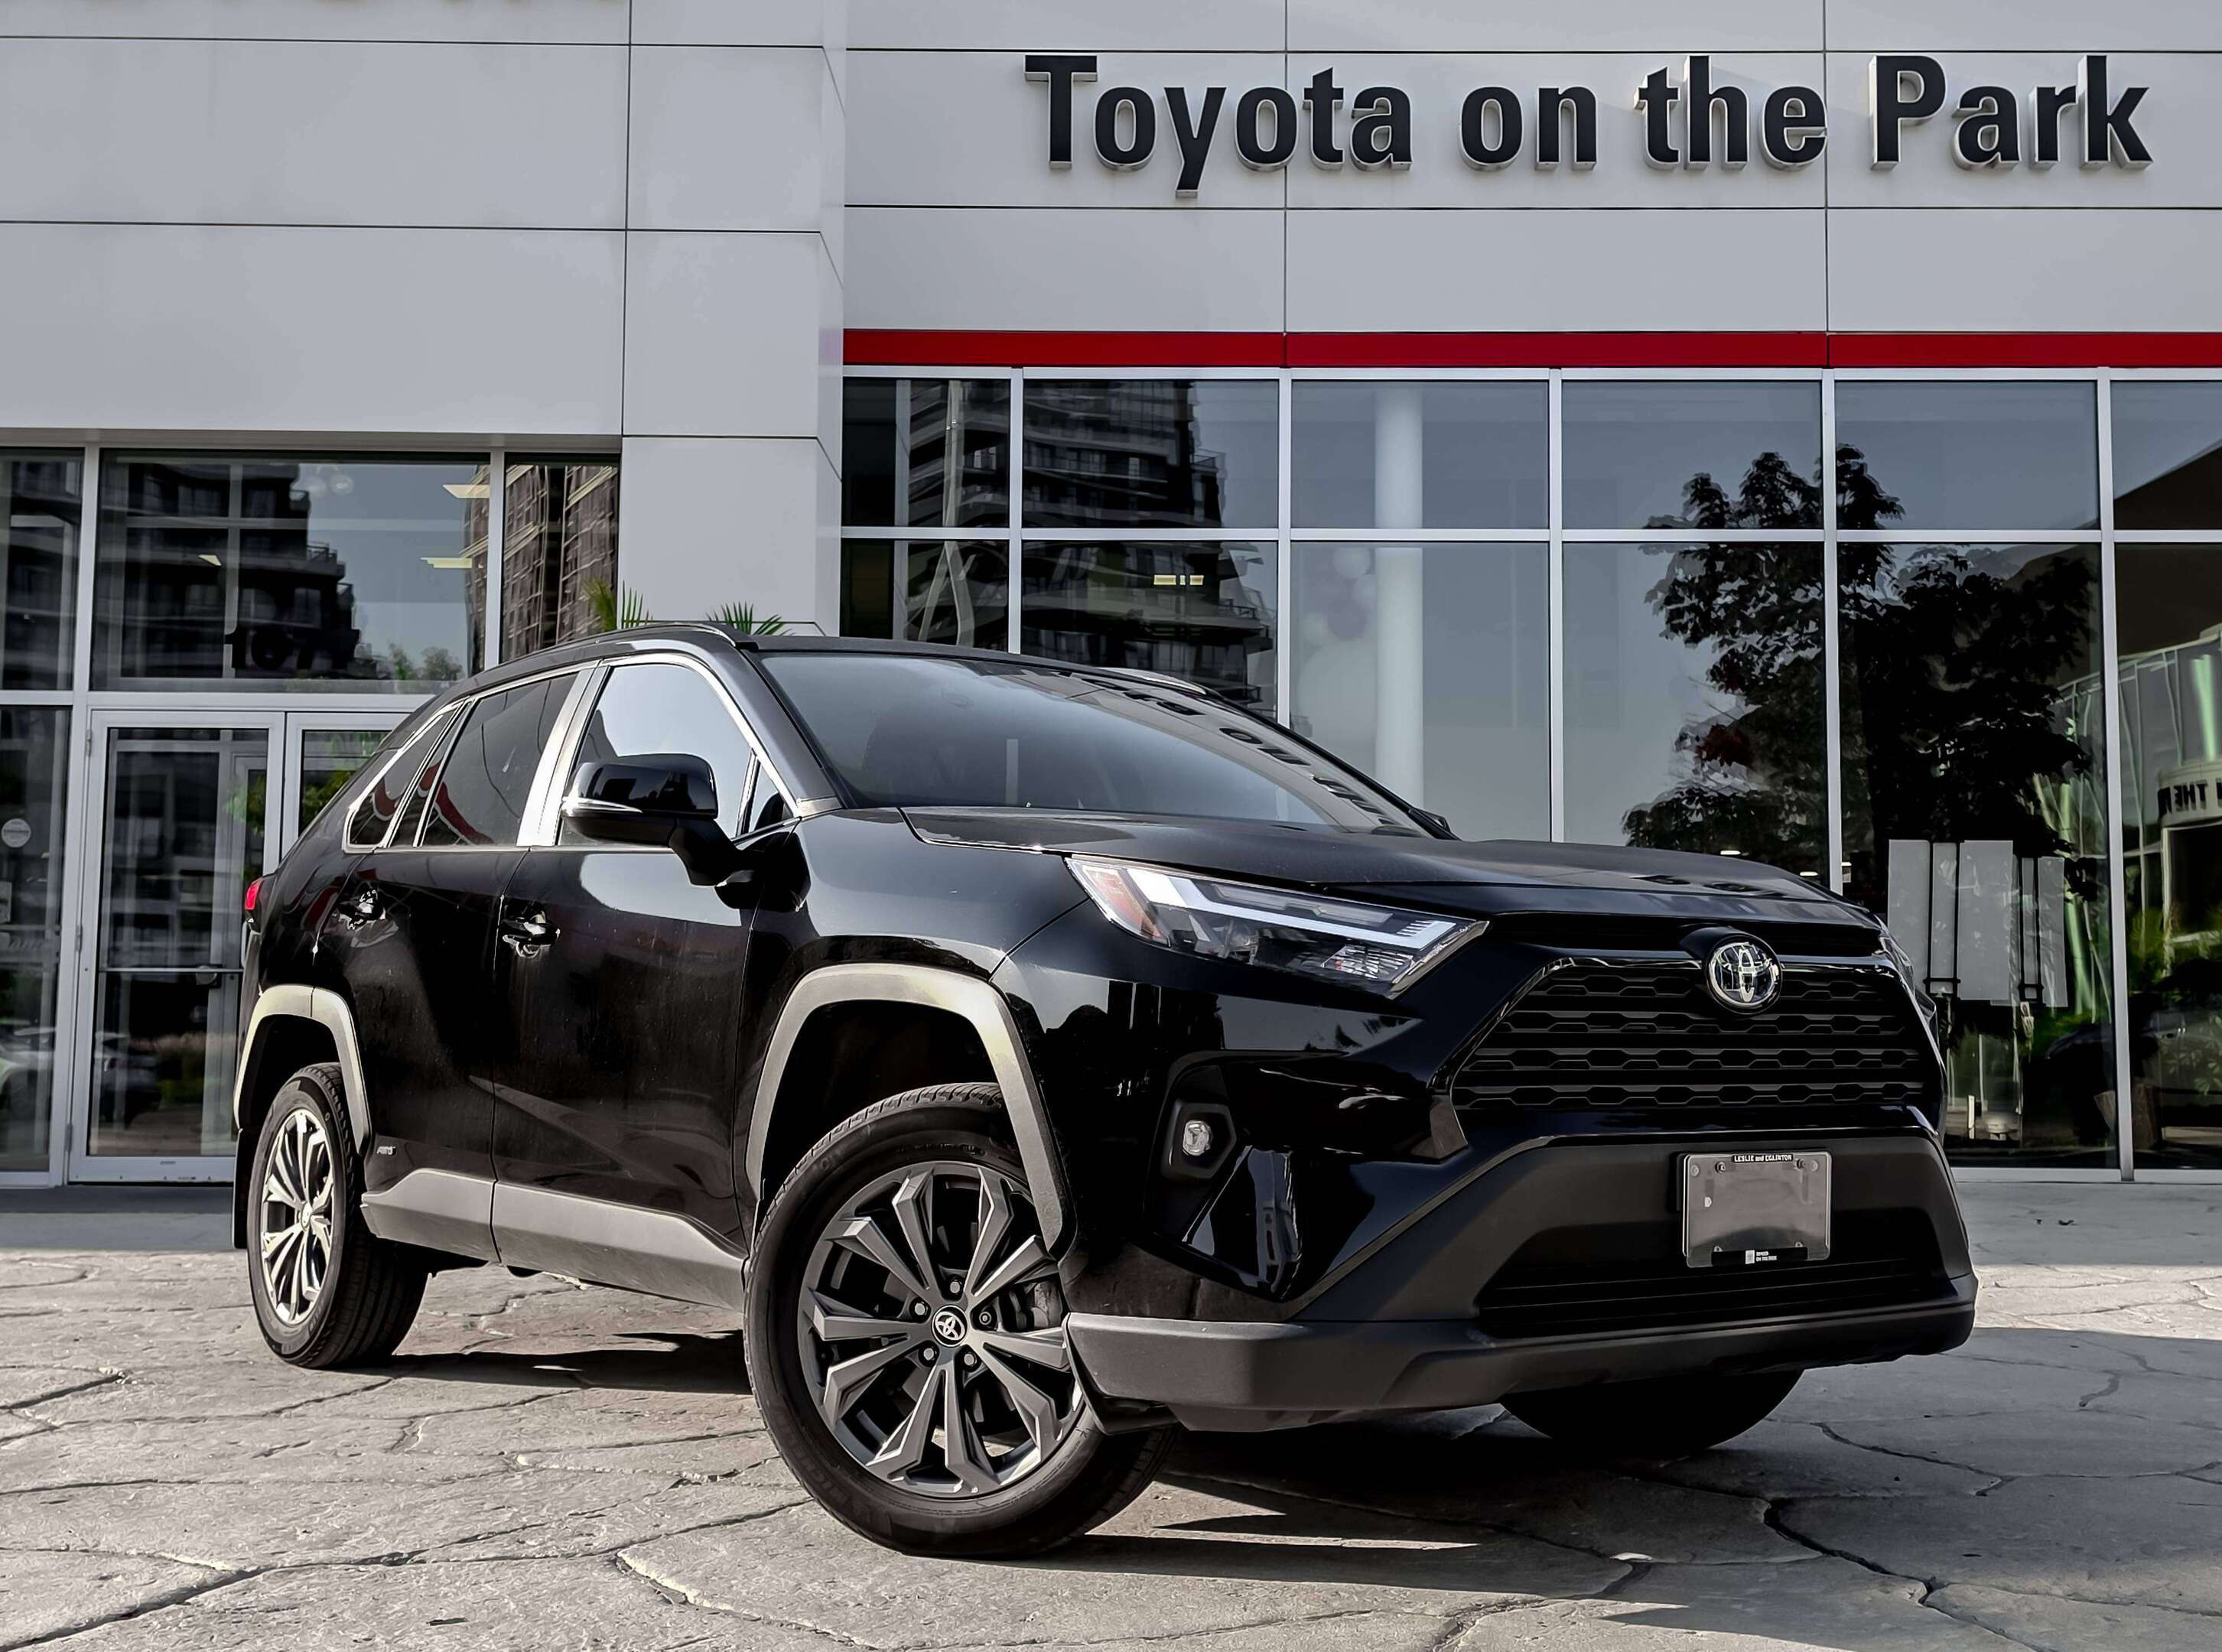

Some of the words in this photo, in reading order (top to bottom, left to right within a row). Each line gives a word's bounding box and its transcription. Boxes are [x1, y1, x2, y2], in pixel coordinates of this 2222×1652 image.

[1025, 54, 1412, 197] Toyota
[1459, 86, 1597, 171] on
[1633, 54, 1828, 171] the
[1869, 54, 2153, 171] Park
